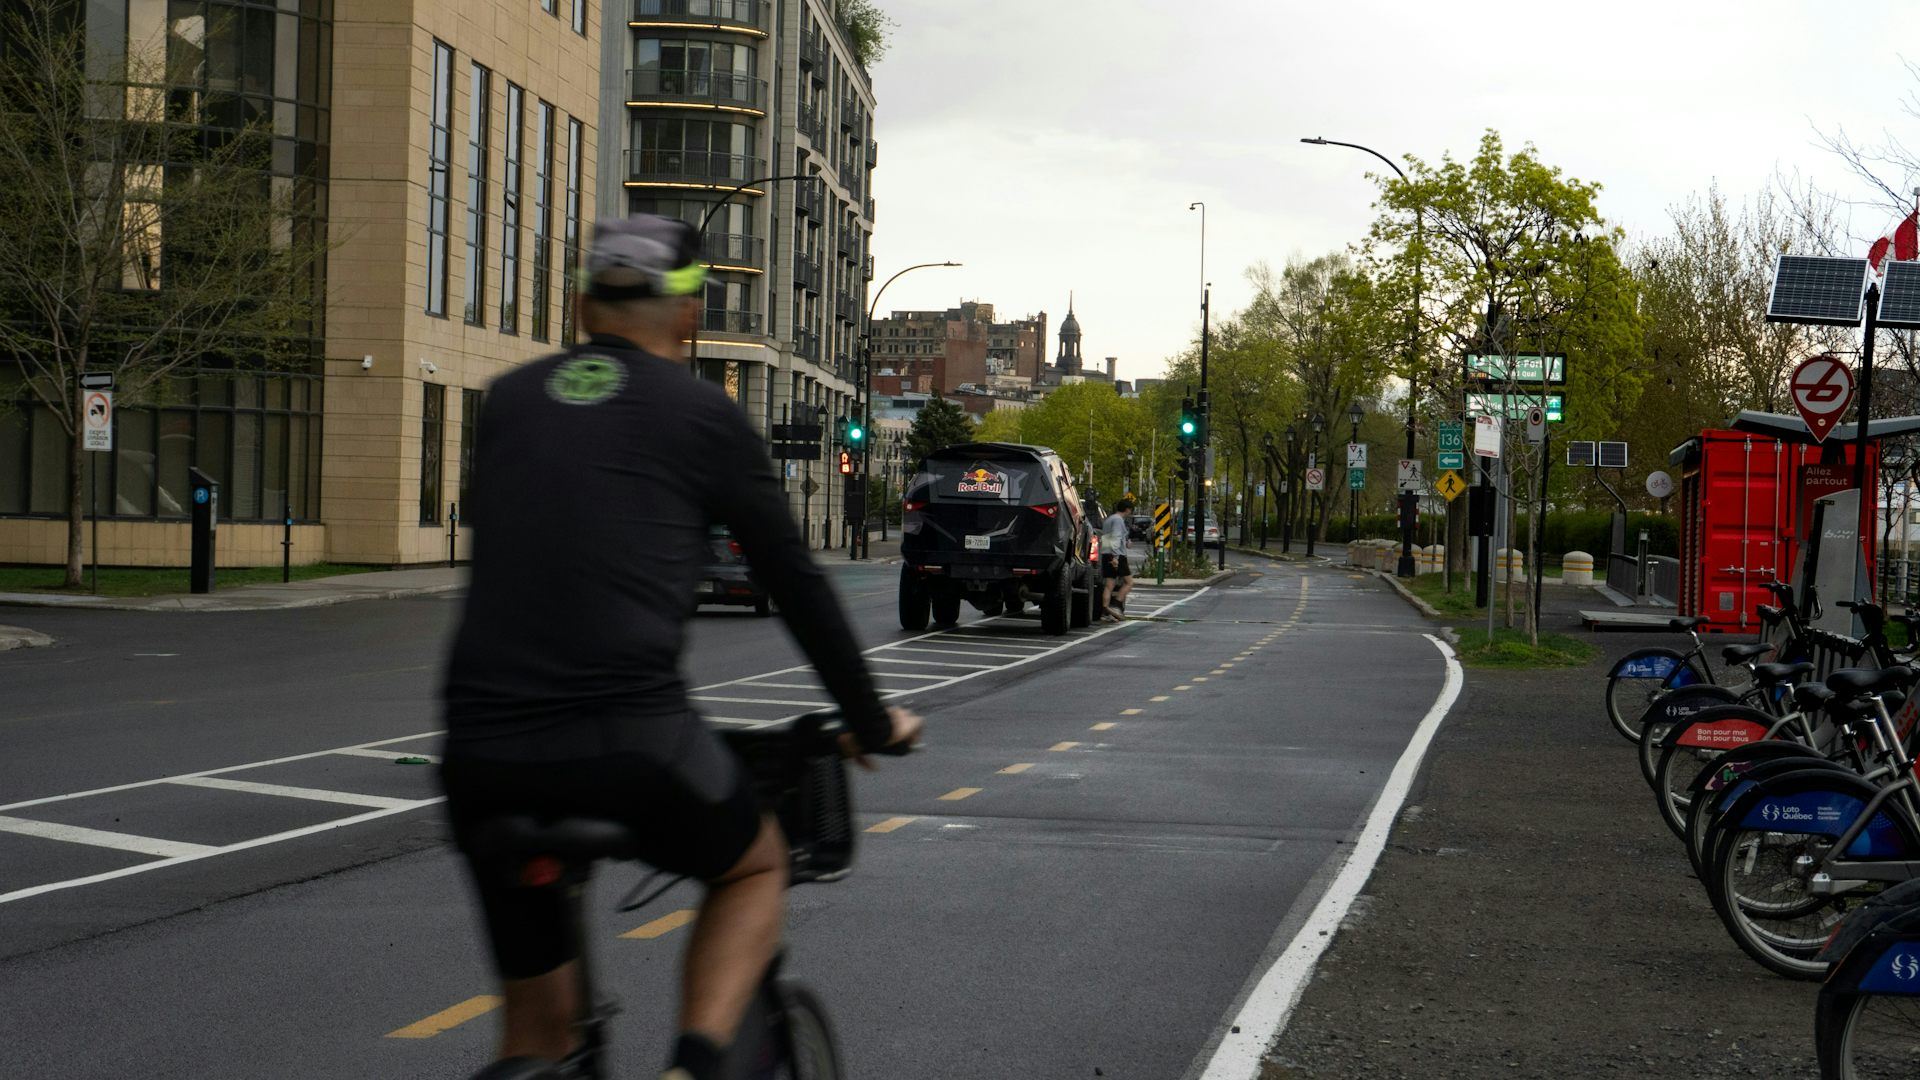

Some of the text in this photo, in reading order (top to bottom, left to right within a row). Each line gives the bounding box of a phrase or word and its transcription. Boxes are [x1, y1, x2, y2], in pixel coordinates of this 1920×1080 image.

[1495, 358, 1543, 369] Vix-Port
[1522, 370, 1537, 378] Quai
[1441, 433, 1460, 446] 136
[1806, 466, 1832, 475] Allez
[1806, 477, 1848, 486] partout
[958, 483, 1001, 492] Red Bull
[1782, 805, 1800, 813] Loto
[1782, 812, 1813, 820] Québec
